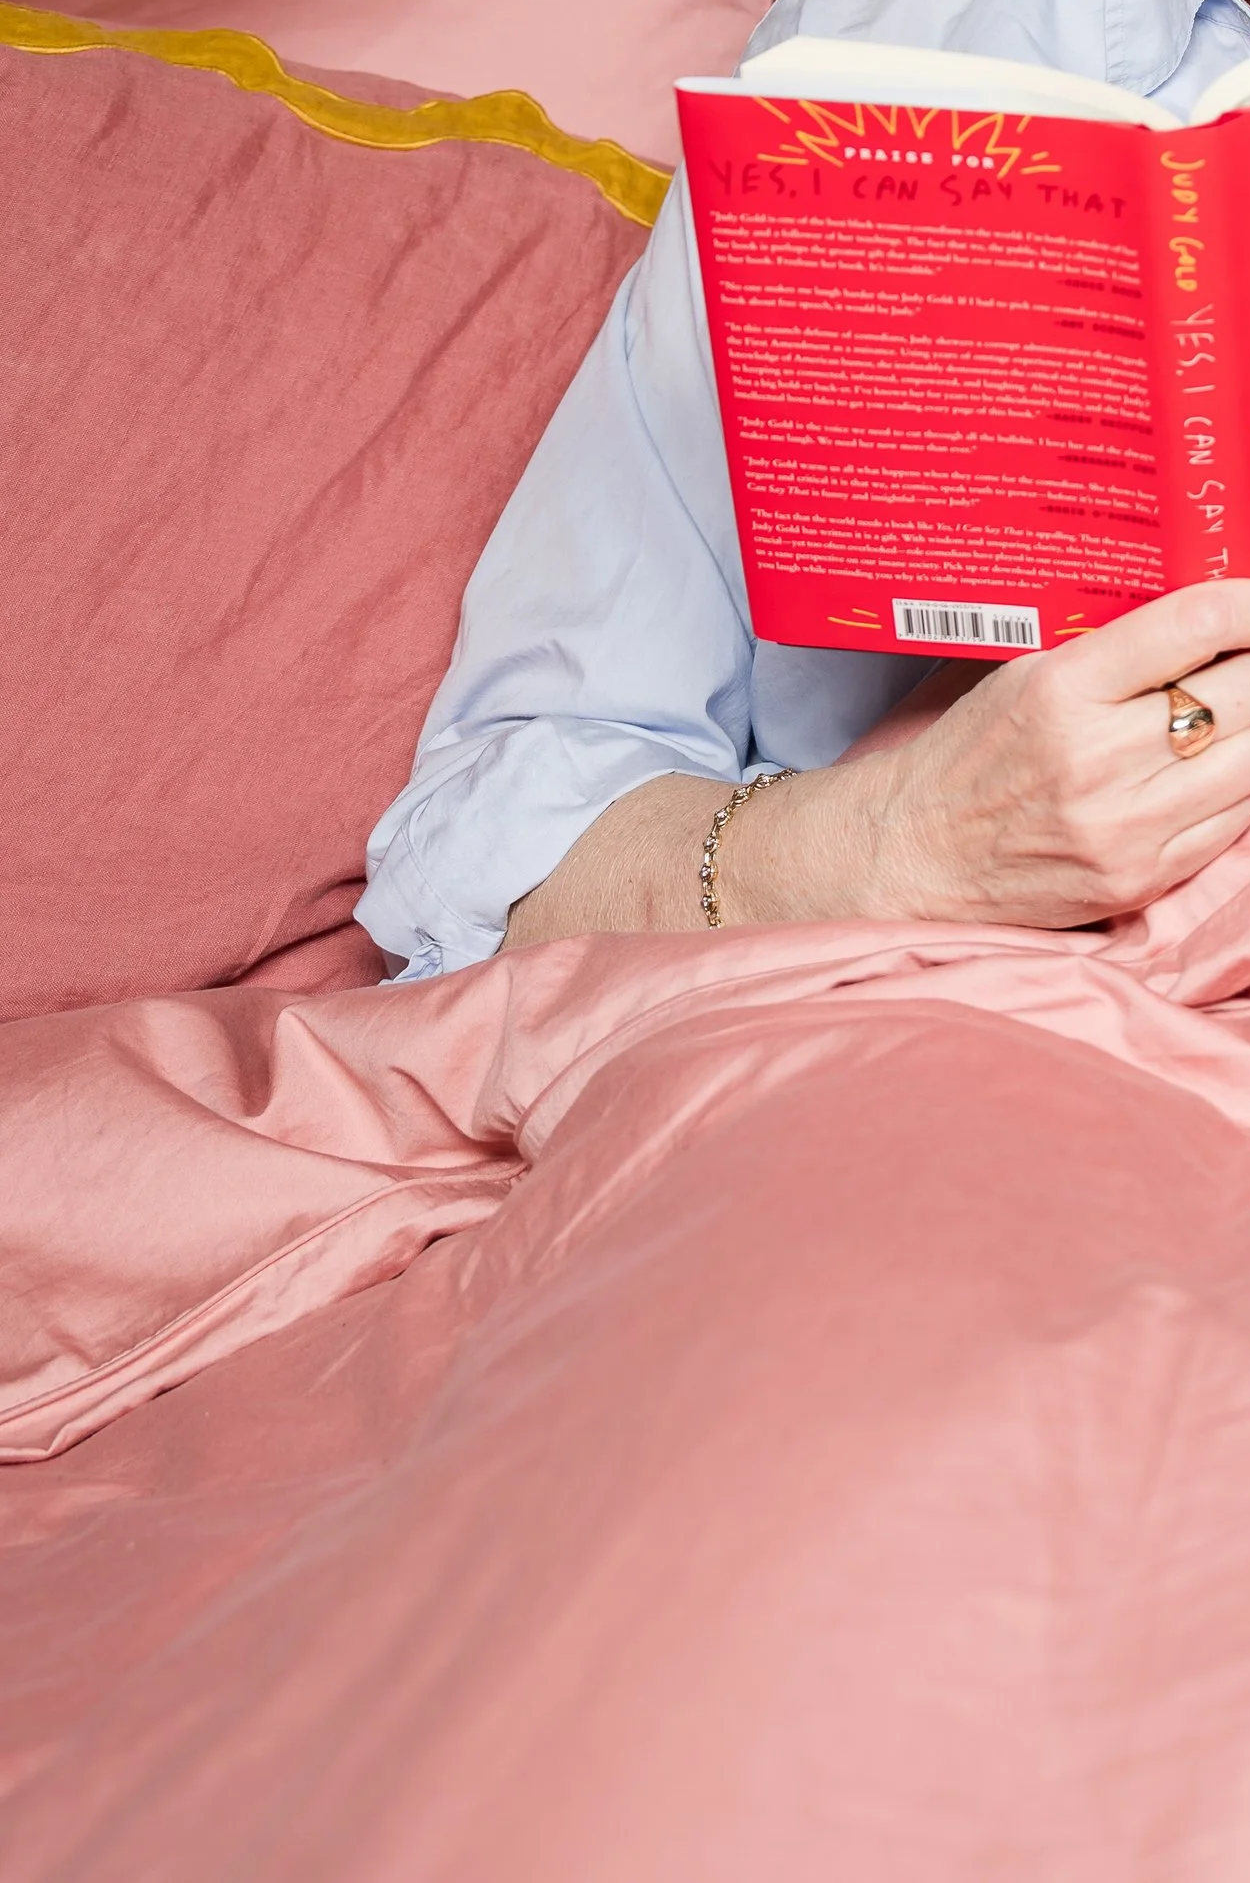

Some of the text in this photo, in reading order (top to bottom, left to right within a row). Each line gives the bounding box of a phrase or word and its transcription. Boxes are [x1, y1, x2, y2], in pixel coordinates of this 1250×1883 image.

[709, 159, 1128, 219] YES, I CAN SAY THAT
[844, 146, 995, 169] PRAISE FOR
[1159, 150, 1206, 293] JUDY GOLD
[1171, 303, 1229, 580] YES, I CAN SAY TH
